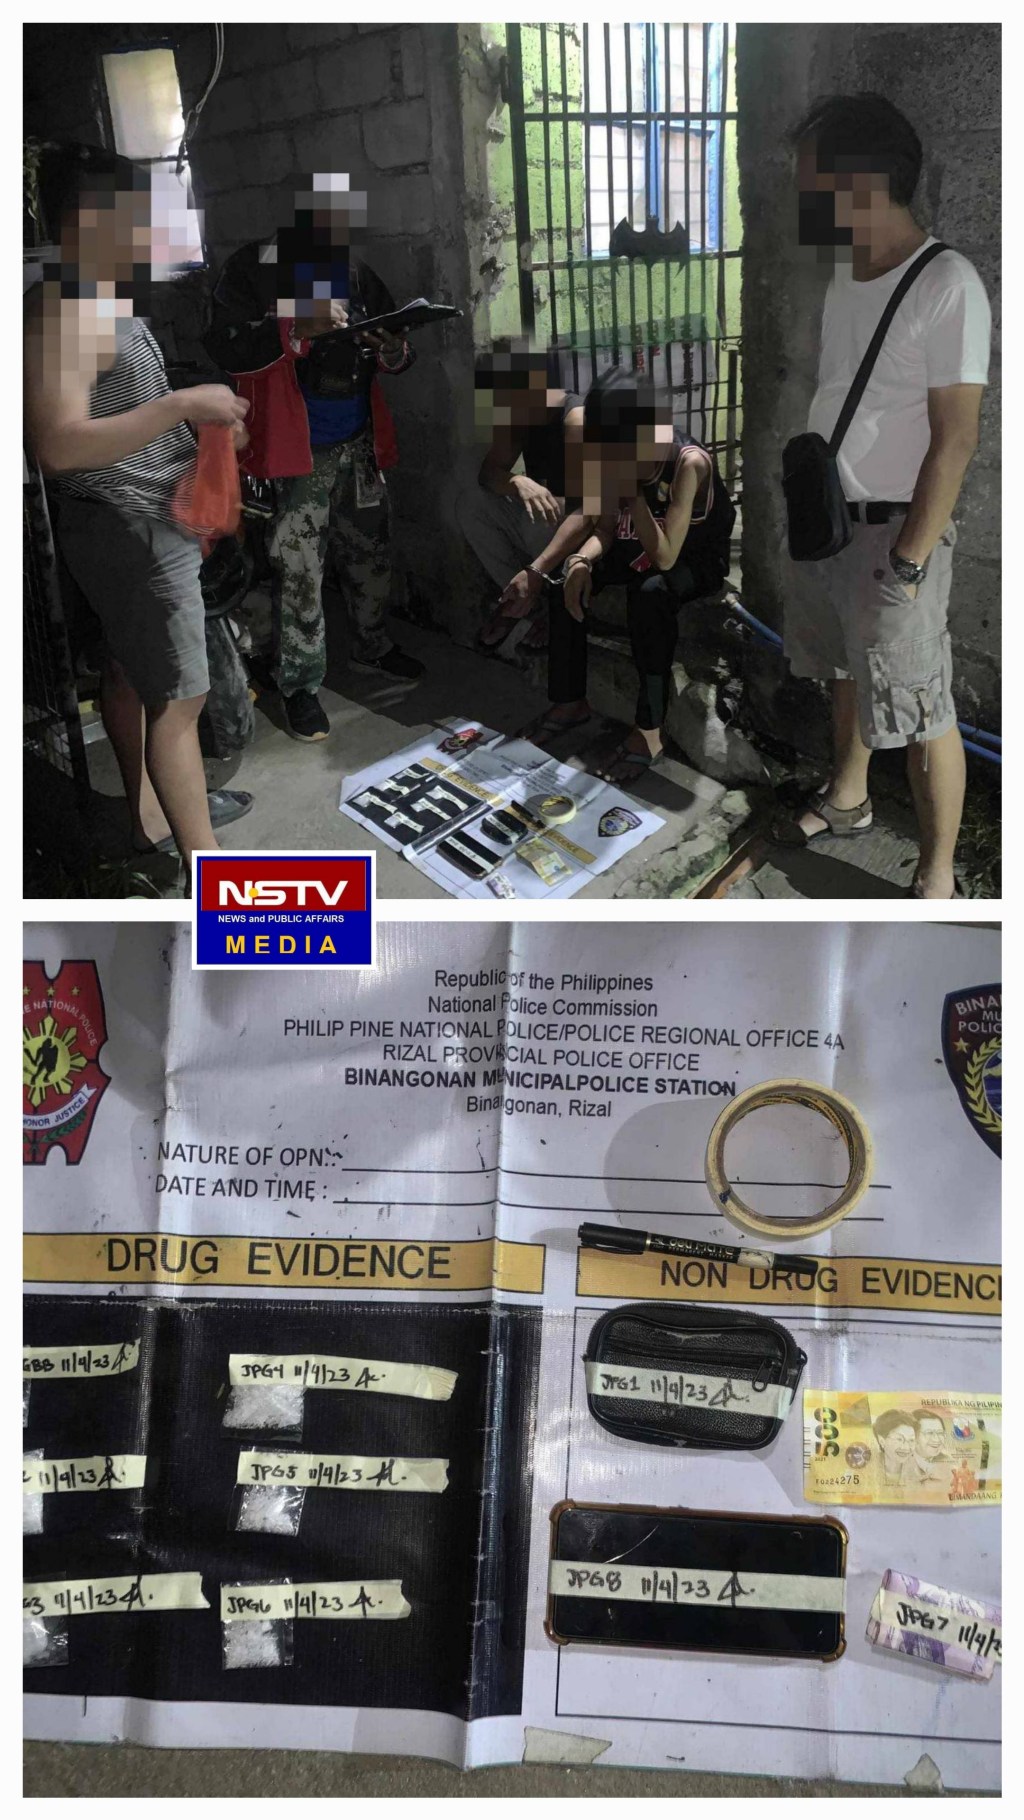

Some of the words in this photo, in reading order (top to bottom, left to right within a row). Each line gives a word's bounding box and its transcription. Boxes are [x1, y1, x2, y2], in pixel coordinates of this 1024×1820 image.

[434, 970, 506, 991] Republic
[511, 971, 525, 988] of
[529, 973, 554, 990] the
[561, 974, 653, 994] Philippines
[428, 994, 496, 1014] National
[501, 992, 547, 1015] Police
[553, 999, 658, 1017] Commission
[955, 995, 1002, 1016] BINA
[33, 999, 80, 1018] NATIONAL
[79, 1014, 98, 1047] POLICE
[284, 1019, 344, 1037] PHILIP
[350, 1021, 394, 1038] PINE
[400, 1021, 494, 1038] NATIONAL
[497, 1019, 635, 1042] POLICE/POLICE
[642, 1025, 740, 1047] REGIONAL
[746, 1029, 819, 1048] OFFICE
[824, 1033, 844, 1050] 4A
[384, 1044, 437, 1062] RIZAL
[553, 1049, 623, 1068] POLICE
[629, 1051, 699, 1071] OFFICE
[345, 1067, 475, 1088] BINANGONAN
[655, 1078, 736, 1097] STATION
[55, 1097, 85, 1122] JUSTICE
[569, 1099, 611, 1117] Rizal
[158, 1142, 239, 1166] NATURE
[245, 1147, 273, 1166] OF
[155, 1174, 206, 1197] DATE
[212, 1178, 258, 1198] AND
[264, 1179, 316, 1200] TIME
[107, 1237, 219, 1275] DRUG
[247, 1242, 452, 1280] EVIDENCE
[661, 1260, 728, 1289] NON
[862, 1266, 1002, 1301] EVIDENC
[241, 1363, 284, 1379] JPG4
[601, 1373, 640, 1391] JPG1
[813, 1407, 840, 1457] 500
[250, 1463, 299, 1482] JPG5
[567, 1568, 622, 1593] JPG8
[227, 1596, 272, 1614] JPG6
